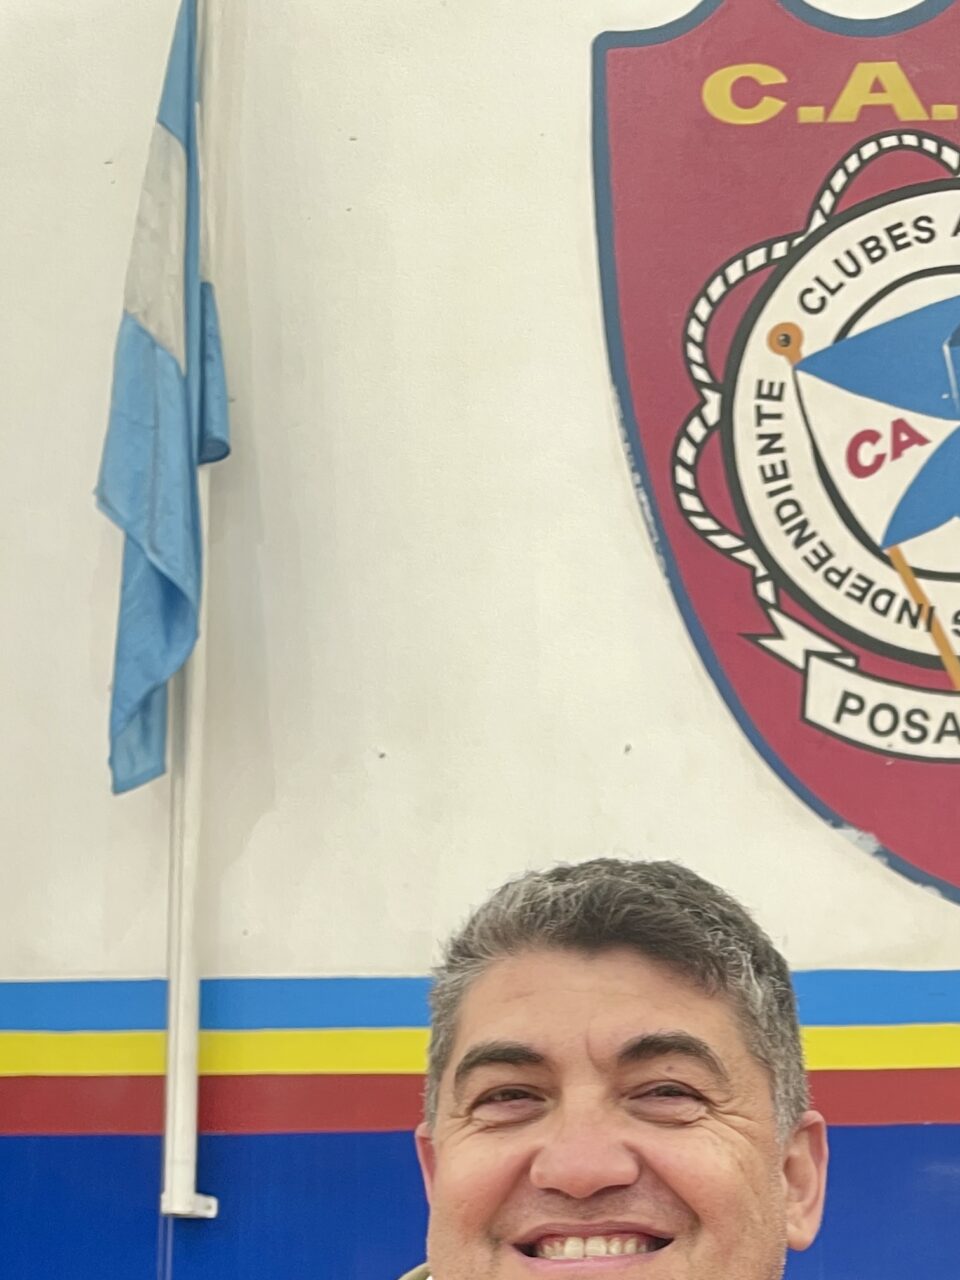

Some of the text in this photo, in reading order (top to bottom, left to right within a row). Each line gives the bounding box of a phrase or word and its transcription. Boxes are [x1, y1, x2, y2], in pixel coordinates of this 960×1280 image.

[797, 214, 937, 317] CLUBES
[844, 418, 933, 480] CA
[755, 379, 936, 635] INDEPENDIENTE
